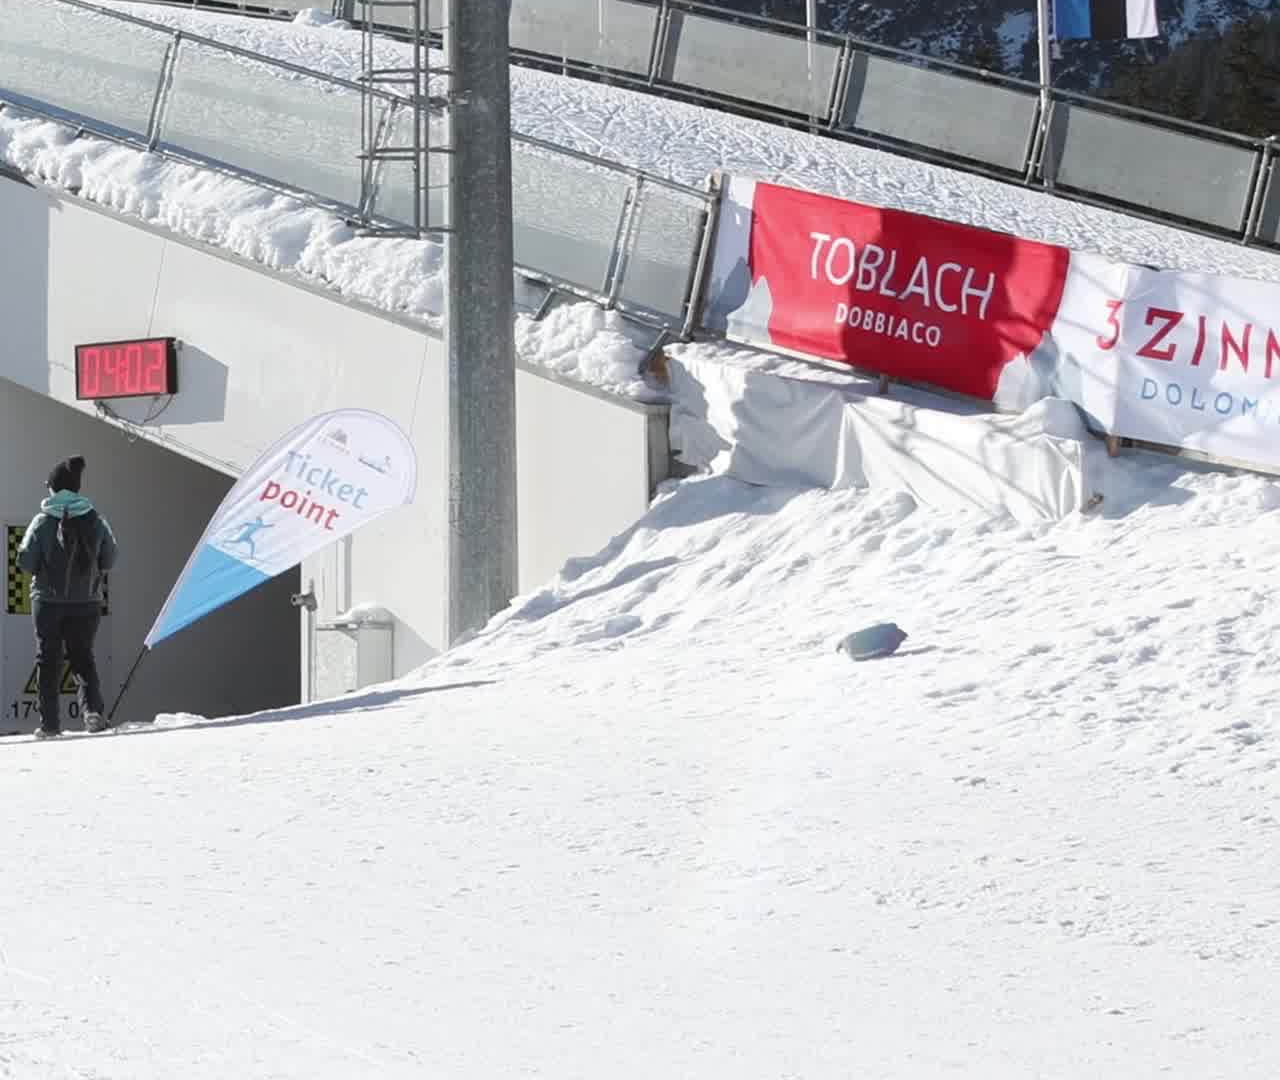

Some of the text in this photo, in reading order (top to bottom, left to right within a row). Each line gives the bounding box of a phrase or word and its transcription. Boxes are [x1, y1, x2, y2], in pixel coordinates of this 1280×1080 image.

[810, 231, 995, 320] TOBLACH
[835, 303, 941, 347] DOBBIACO
[1096, 299, 1124, 350] 3
[83, 342, 164, 397] 04:02
[260, 480, 340, 531] point
[285, 451, 369, 510] Ticket
